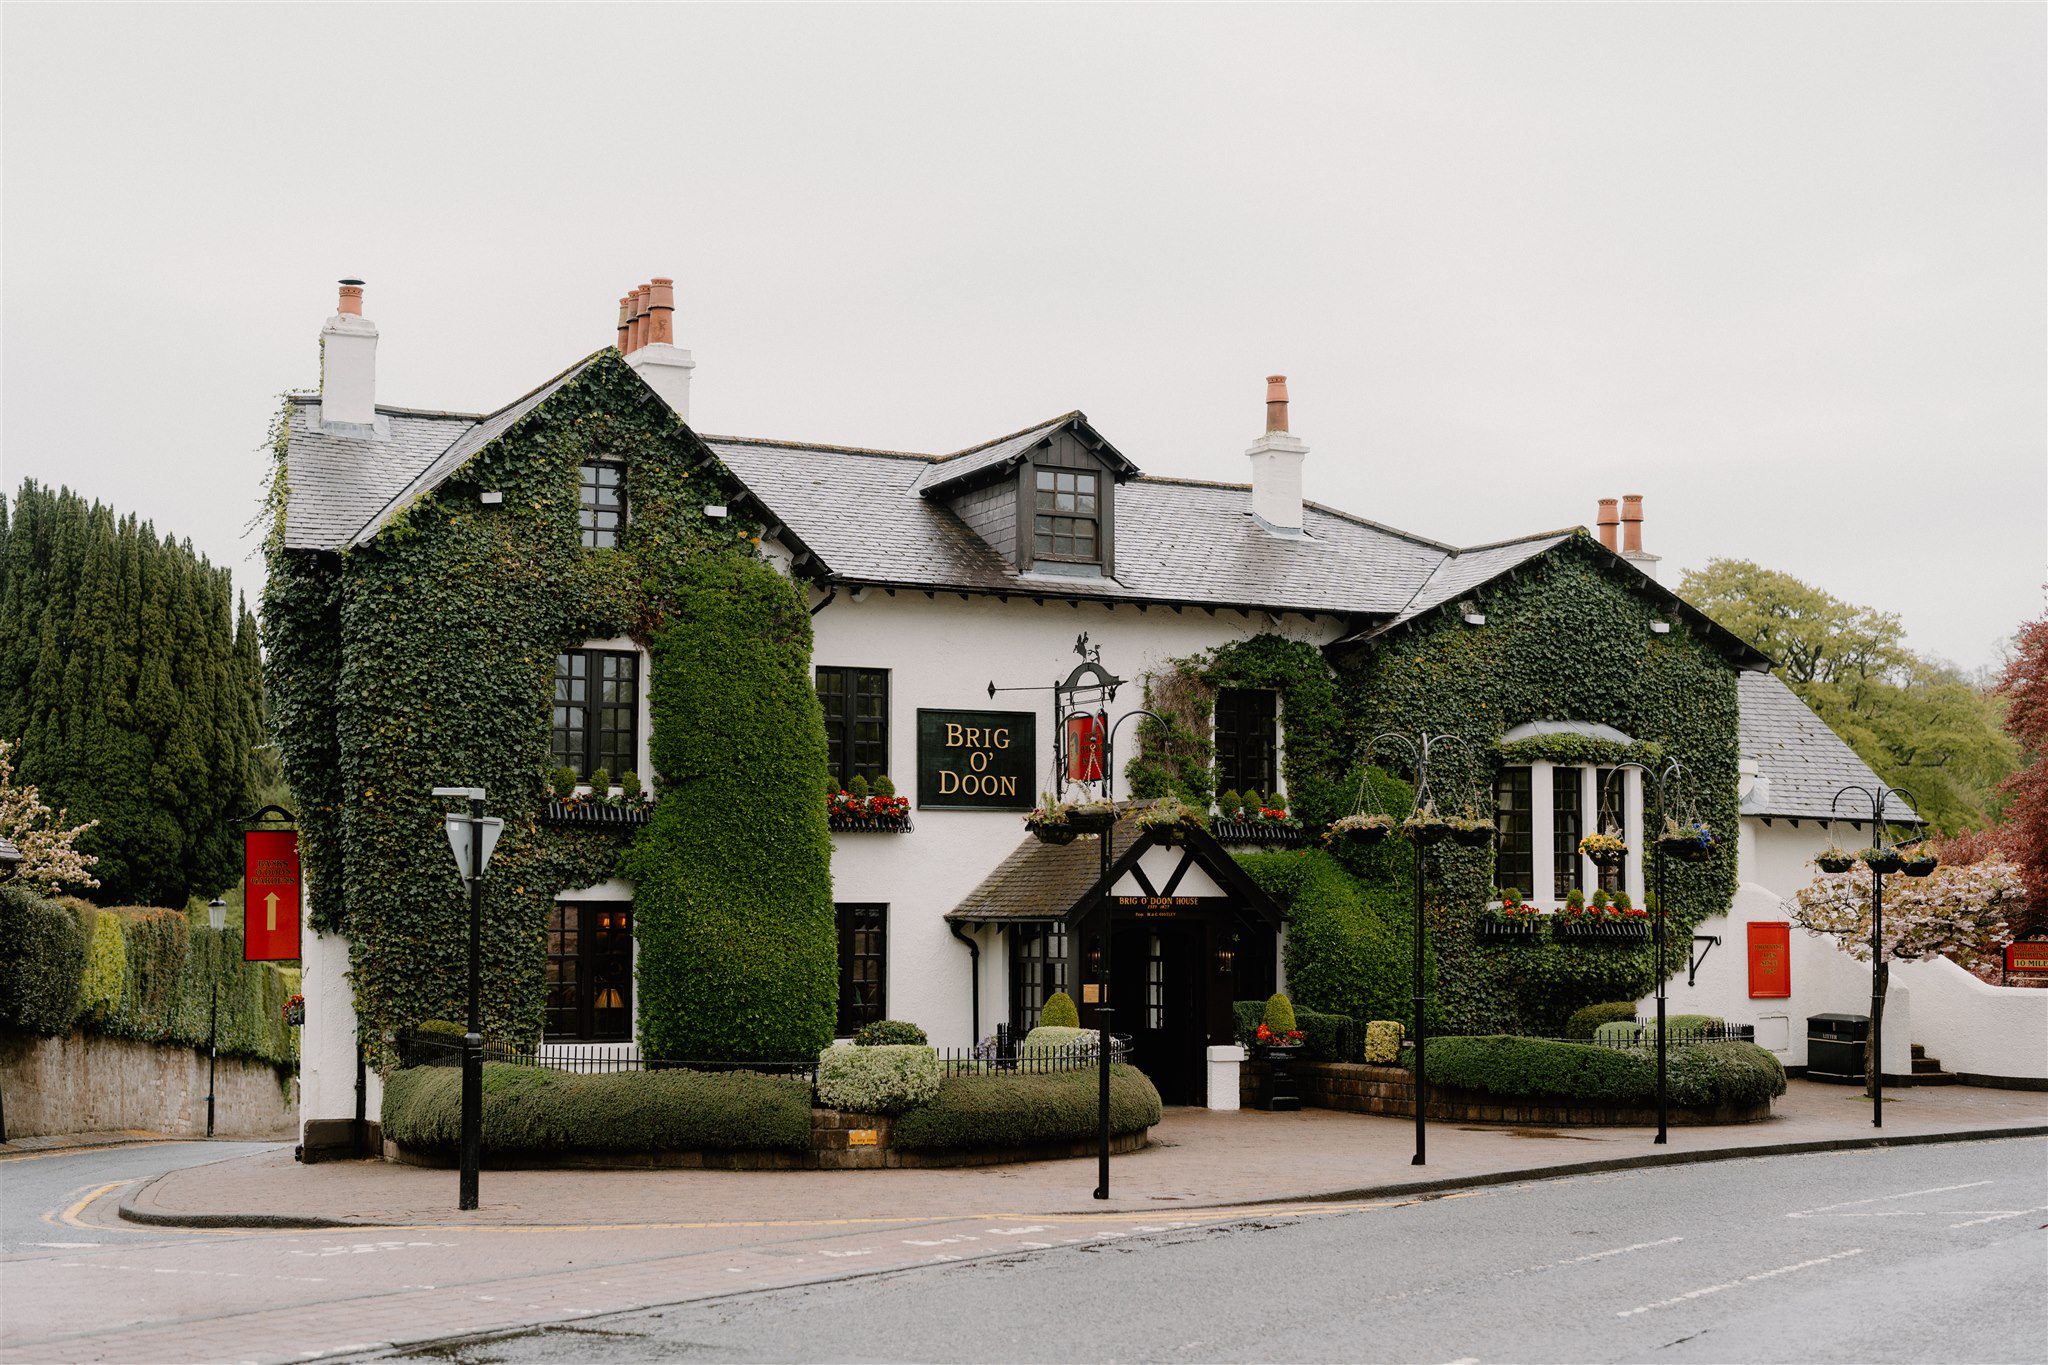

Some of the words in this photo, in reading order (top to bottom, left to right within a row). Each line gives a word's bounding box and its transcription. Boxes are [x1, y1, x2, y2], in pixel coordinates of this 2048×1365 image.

[945, 723, 1010, 749] BRIG
[970, 751, 994, 772] O'
[939, 770, 1017, 797] DOON
[1119, 897, 1138, 905] BRIG
[1150, 897, 1173, 905] DOON
[1176, 897, 1199, 906] HOUSE
